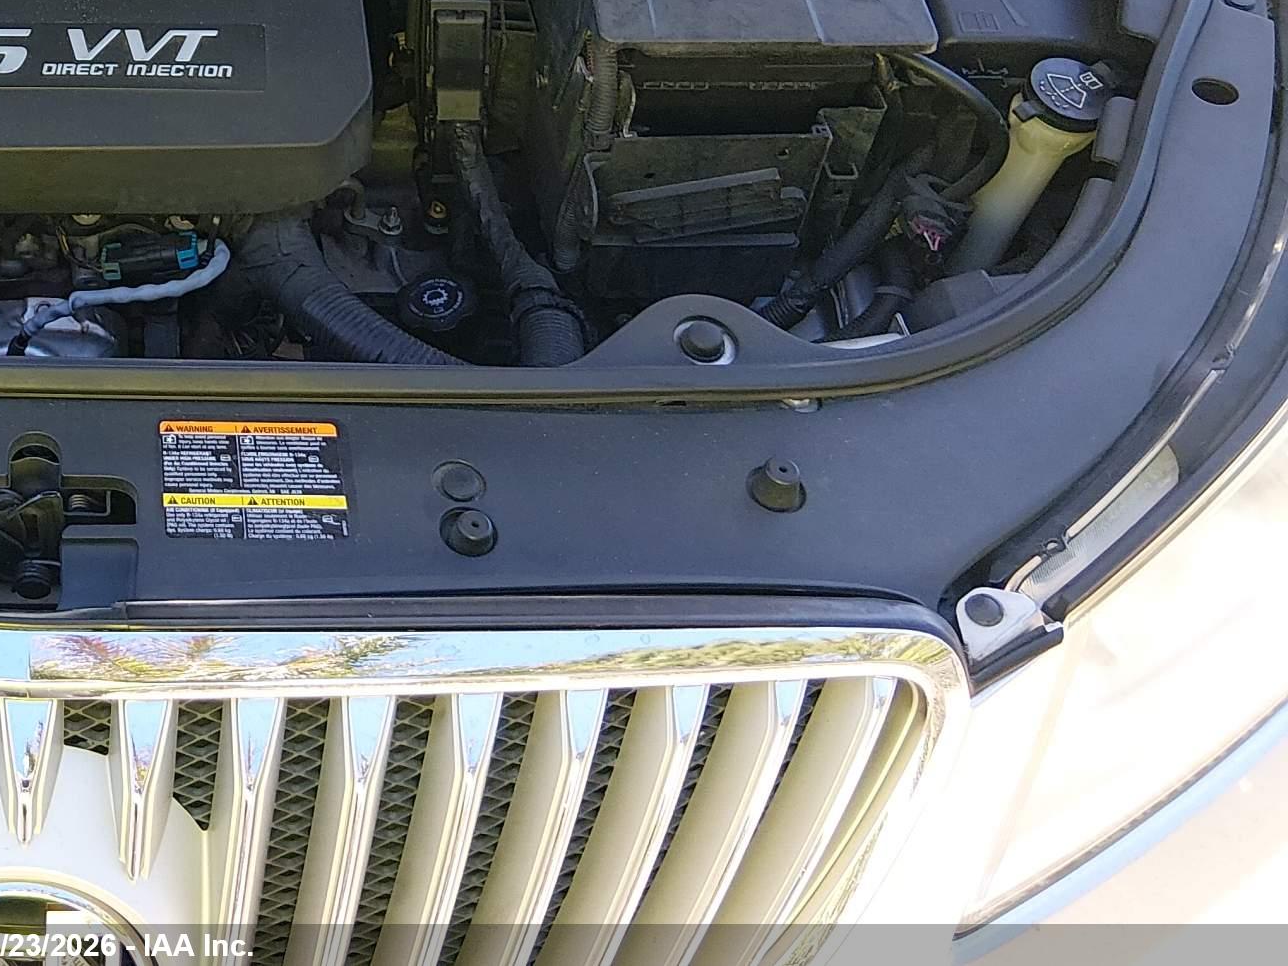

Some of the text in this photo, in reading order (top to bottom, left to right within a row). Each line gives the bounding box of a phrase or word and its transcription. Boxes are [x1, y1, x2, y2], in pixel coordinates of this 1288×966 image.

[67, 28, 219, 62] VVT
[42, 63, 233, 78] DIRECT INJECTION
[175, 425, 213, 433] WARNING
[253, 426, 318, 434] AVERTISSEMENT
[180, 497, 215, 505] CAUTION
[261, 498, 305, 506] ATTENTION
